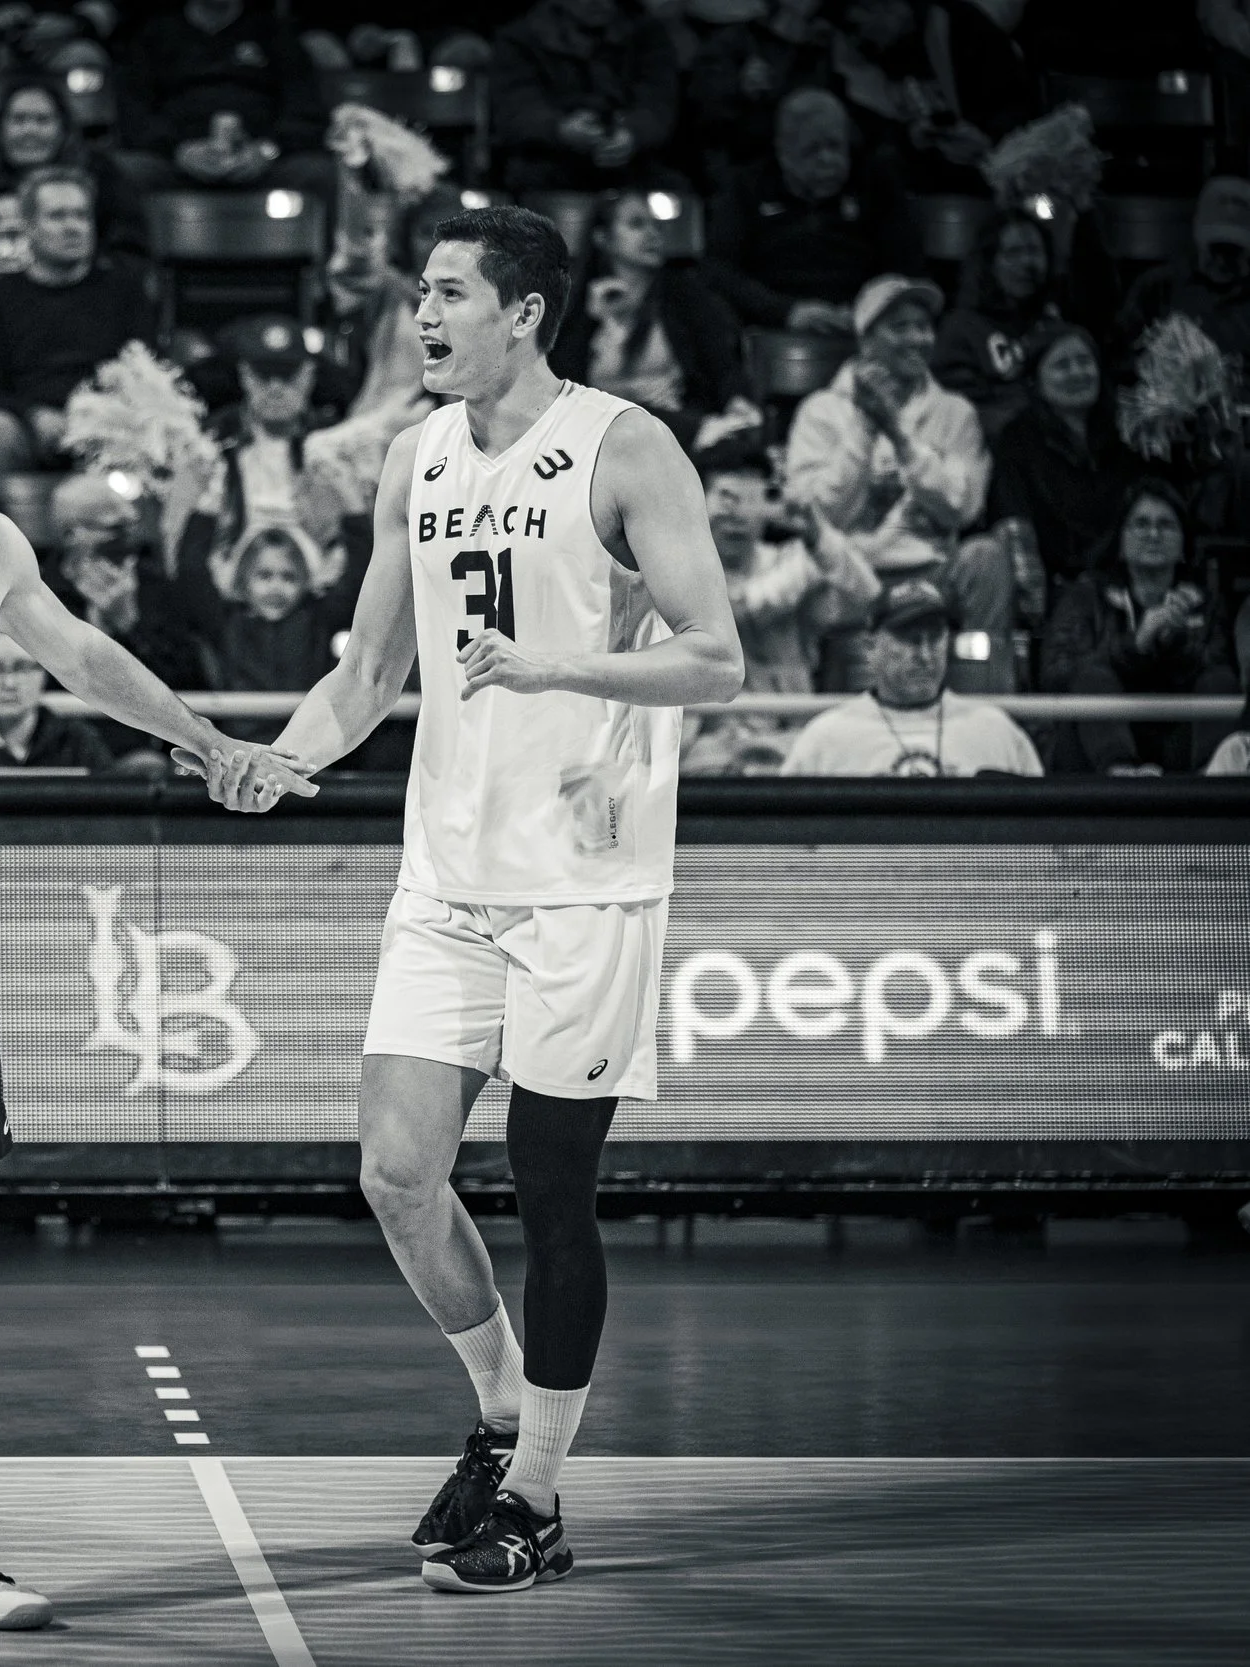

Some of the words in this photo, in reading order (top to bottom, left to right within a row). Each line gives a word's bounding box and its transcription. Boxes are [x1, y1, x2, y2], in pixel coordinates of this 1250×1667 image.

[419, 504, 547, 543] BEACH
[450, 547, 516, 653] 31
[671, 930, 1063, 1063] pepsi
